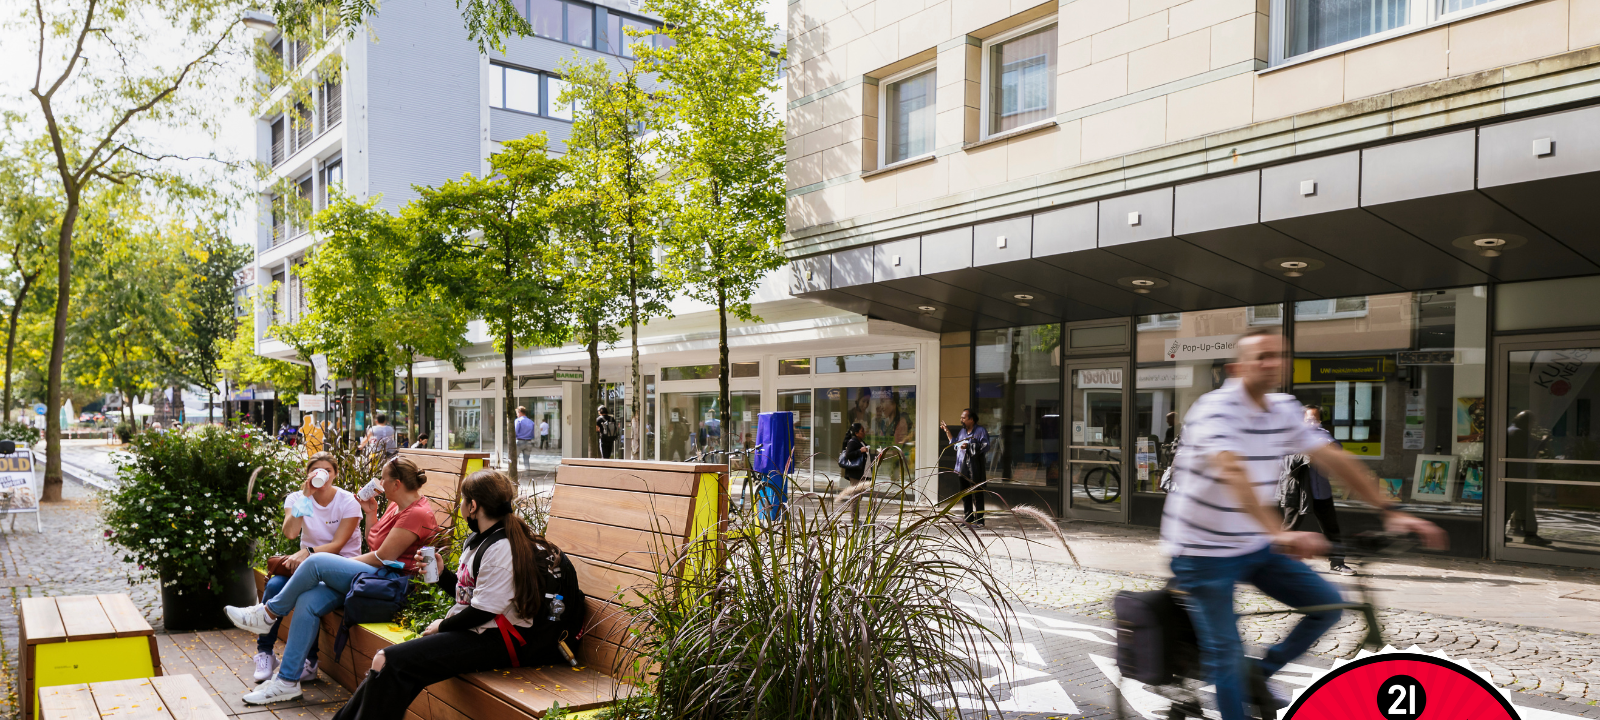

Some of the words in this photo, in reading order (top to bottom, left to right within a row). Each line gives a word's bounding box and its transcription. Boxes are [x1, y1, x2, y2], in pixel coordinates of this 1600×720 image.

[1182, 341, 1237, 353] Pop-Up-Galer
[1534, 349, 1576, 389] KUN
[0, 457, 30, 472] OLD
